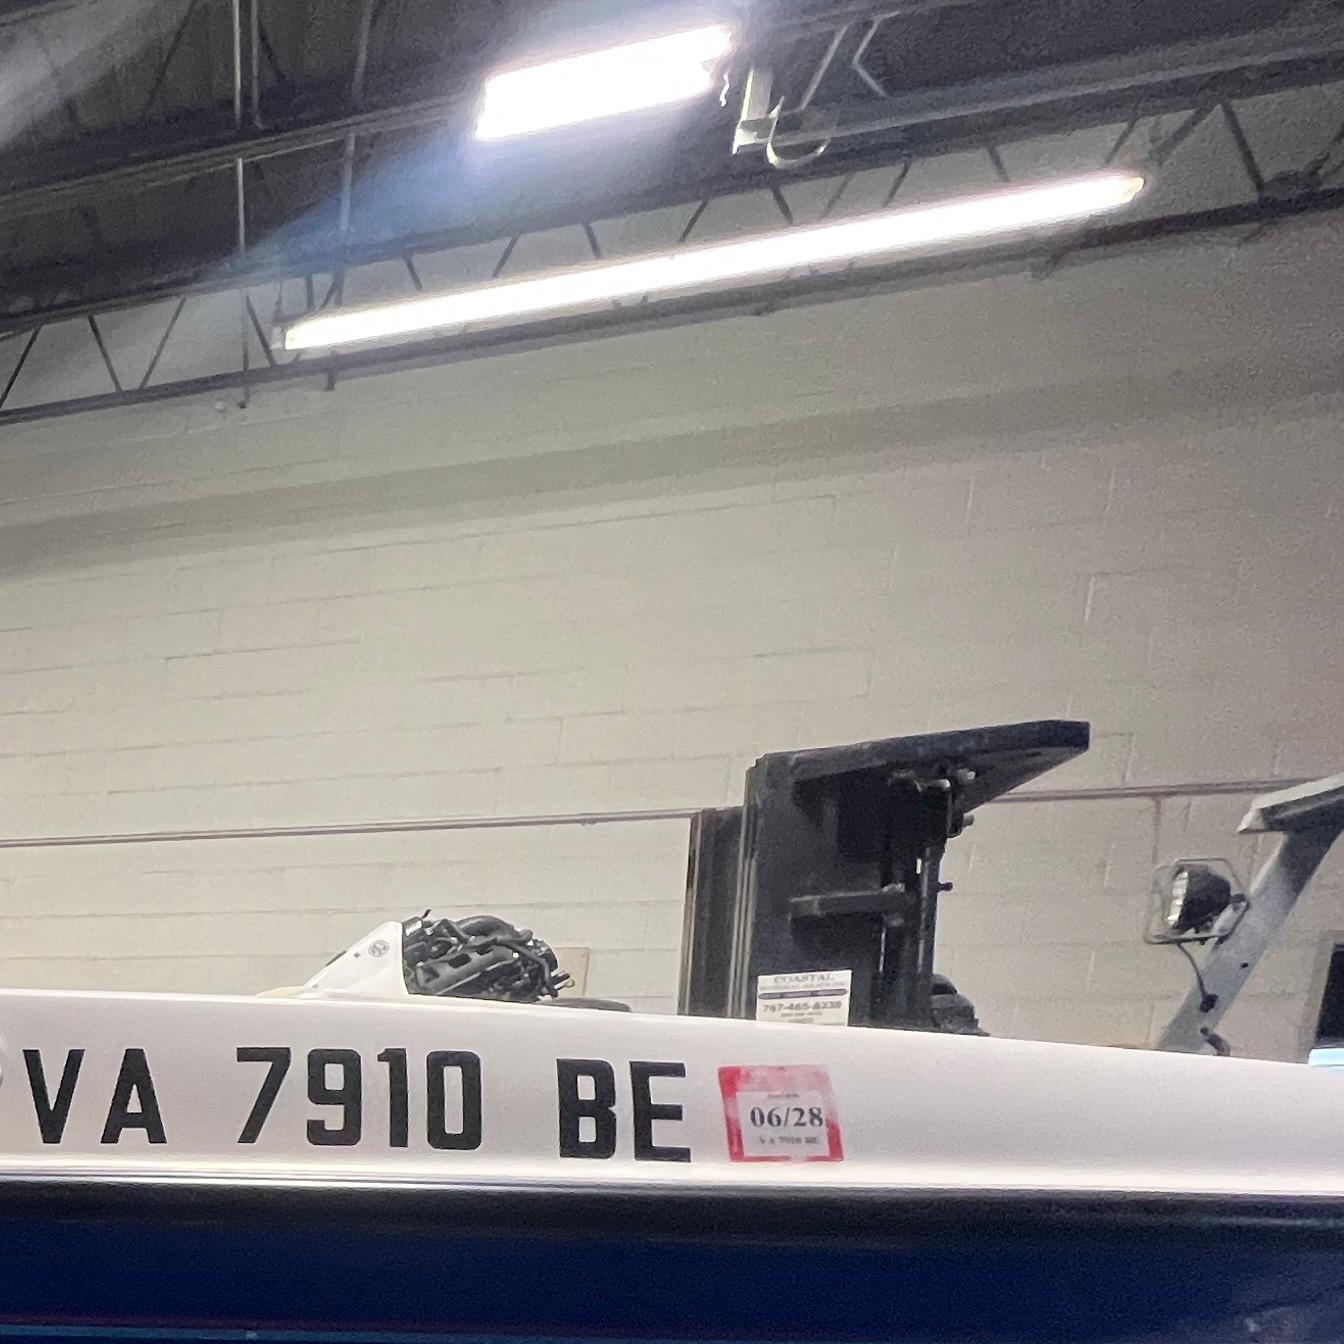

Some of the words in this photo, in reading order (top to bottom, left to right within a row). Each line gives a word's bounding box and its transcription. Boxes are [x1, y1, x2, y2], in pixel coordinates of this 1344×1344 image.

[22, 1048, 168, 1145] VA
[236, 1046, 482, 1151] 7910
[556, 1058, 691, 1163] BE
[750, 1106, 823, 1128] 06/28
